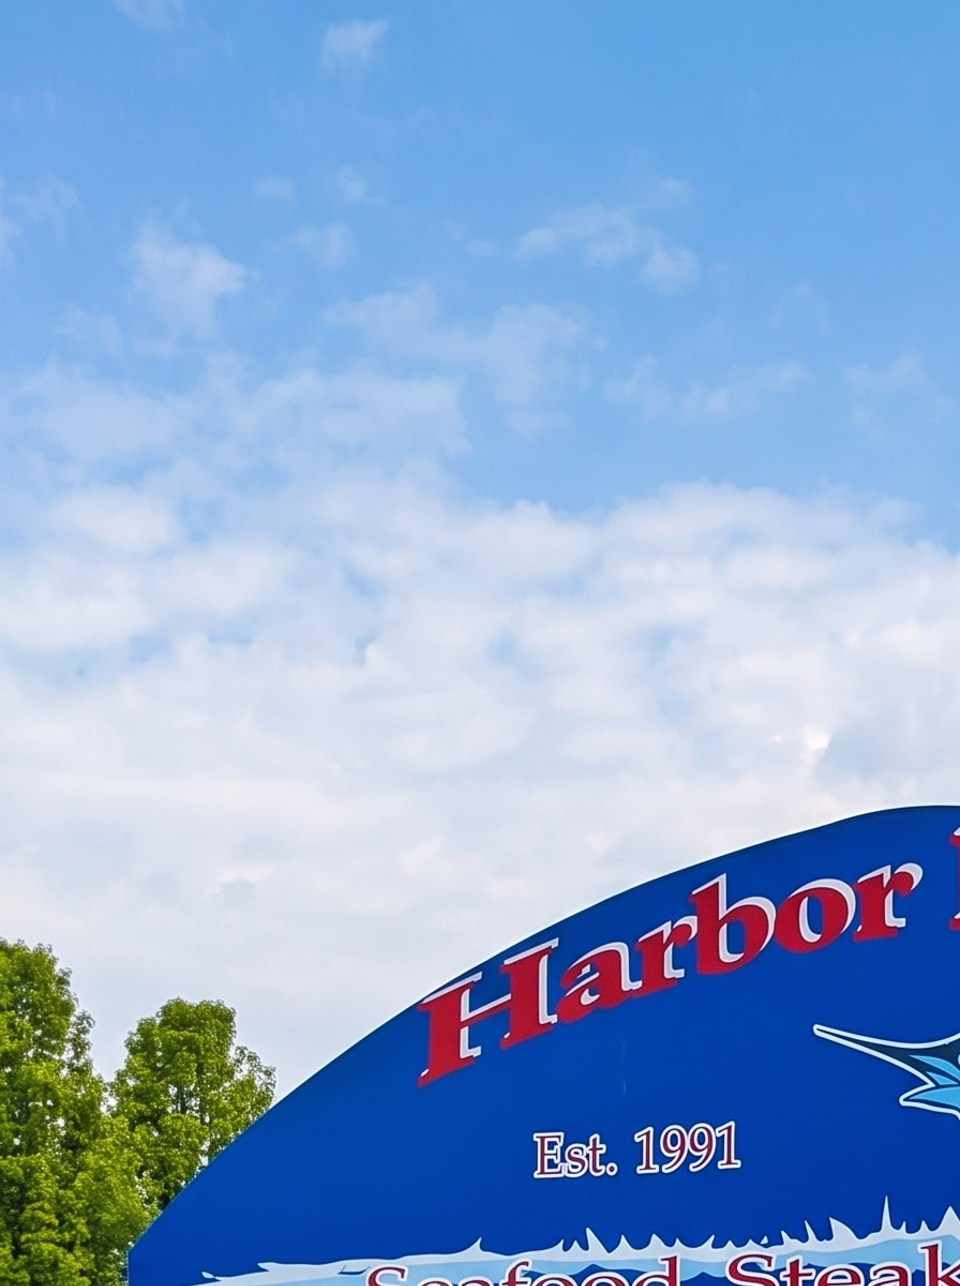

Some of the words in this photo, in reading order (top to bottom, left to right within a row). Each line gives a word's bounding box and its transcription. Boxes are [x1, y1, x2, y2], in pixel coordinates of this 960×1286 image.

[418, 862, 923, 1086] Harbor
[533, 1131, 618, 1178] Est.
[634, 1120, 742, 1174] 1991
